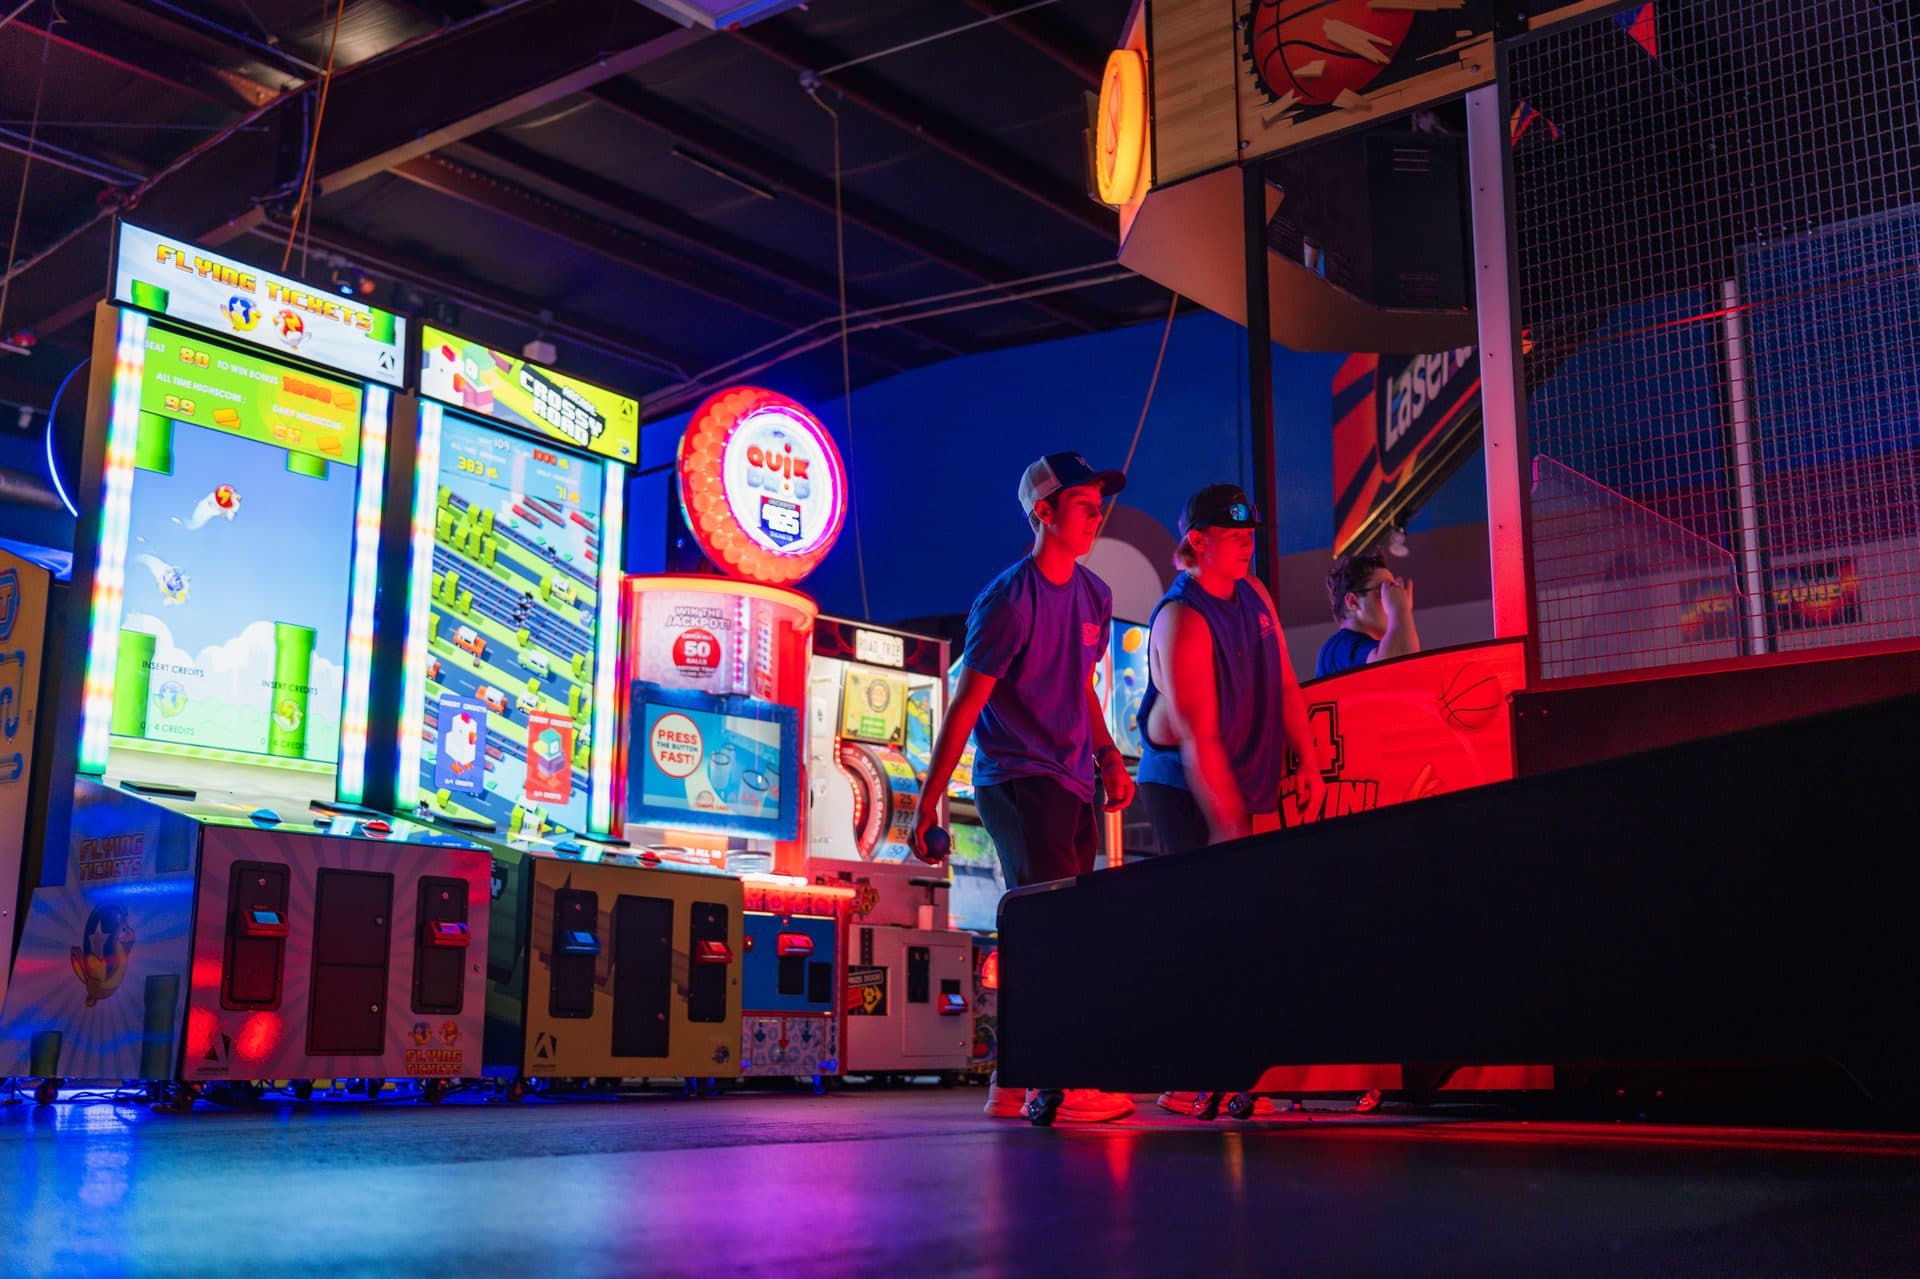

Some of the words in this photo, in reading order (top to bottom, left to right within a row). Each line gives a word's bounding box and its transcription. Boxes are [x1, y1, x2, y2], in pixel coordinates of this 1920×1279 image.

[157, 244, 257, 294] FLYING
[265, 279, 373, 332] TICKETS
[156, 373, 171, 384] ALL
[173, 375, 192, 388] TIME
[217, 360, 229, 371] TO
[231, 364, 247, 377] WIN
[250, 369, 279, 385] BONUS
[164, 394, 195, 416] 99
[519, 370, 604, 437] CROSSY
[533, 397, 589, 447] ROAD
[675, 606, 700, 618] WIN
[700, 608, 723, 620] THE
[665, 616, 731, 631] JACKPOT!
[684, 641, 711, 658] 50
[142, 660, 170, 673] INSERT
[171, 665, 205, 678] CREDITS
[161, 724, 195, 736] CREDITS
[658, 729, 697, 745] PRESS
[657, 741, 670, 749] THE
[672, 743, 698, 752] BUTTON
[660, 751, 696, 766] FAST!
[80, 832, 144, 861] FLYING
[80, 859, 144, 881] TICKETS
[405, 1049, 463, 1063] FLYING
[405, 1063, 463, 1075] TICKETS
